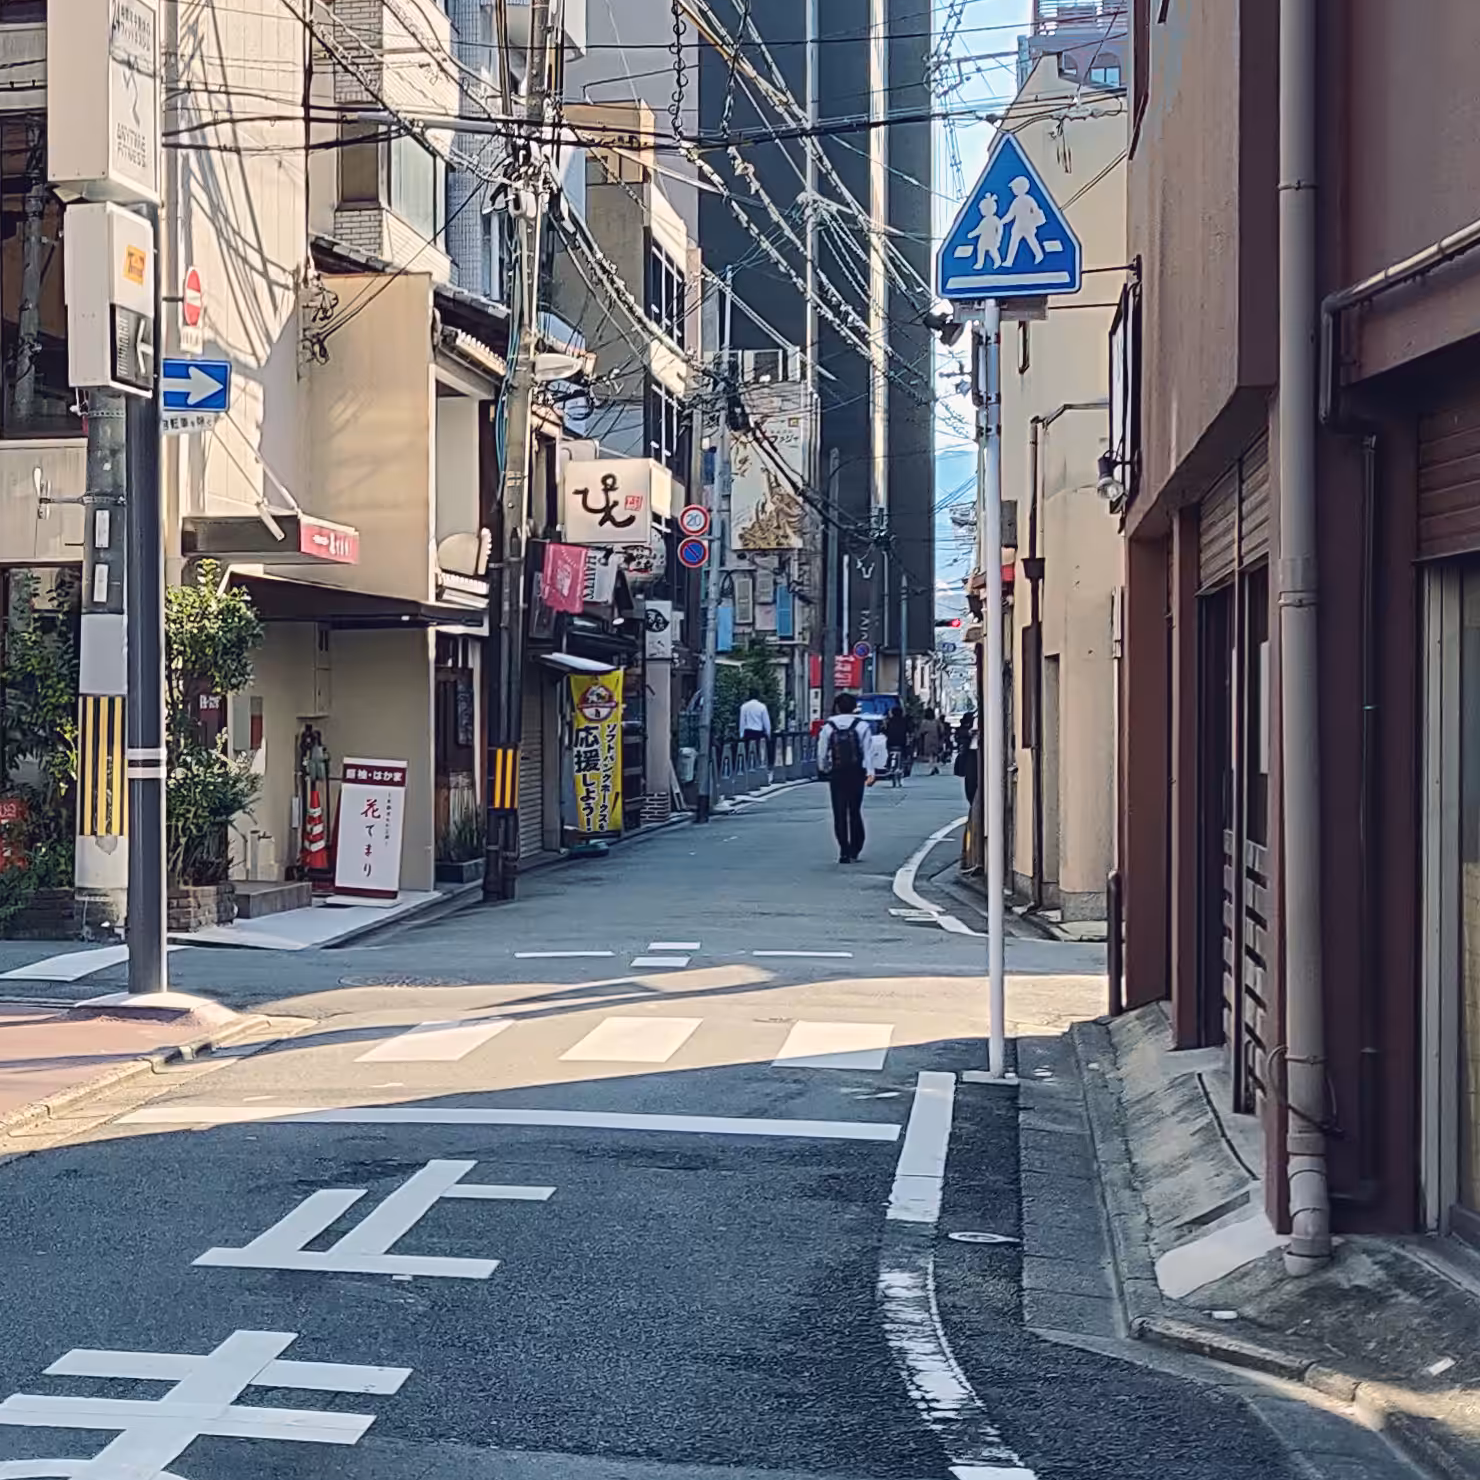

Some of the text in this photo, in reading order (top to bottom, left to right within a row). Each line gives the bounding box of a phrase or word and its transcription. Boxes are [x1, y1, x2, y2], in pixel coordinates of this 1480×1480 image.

[572, 474, 636, 528] ぴん
[686, 513, 701, 527] 20
[574, 725, 601, 832] 応援しよう!
[360, 798, 381, 878] 花てまり
